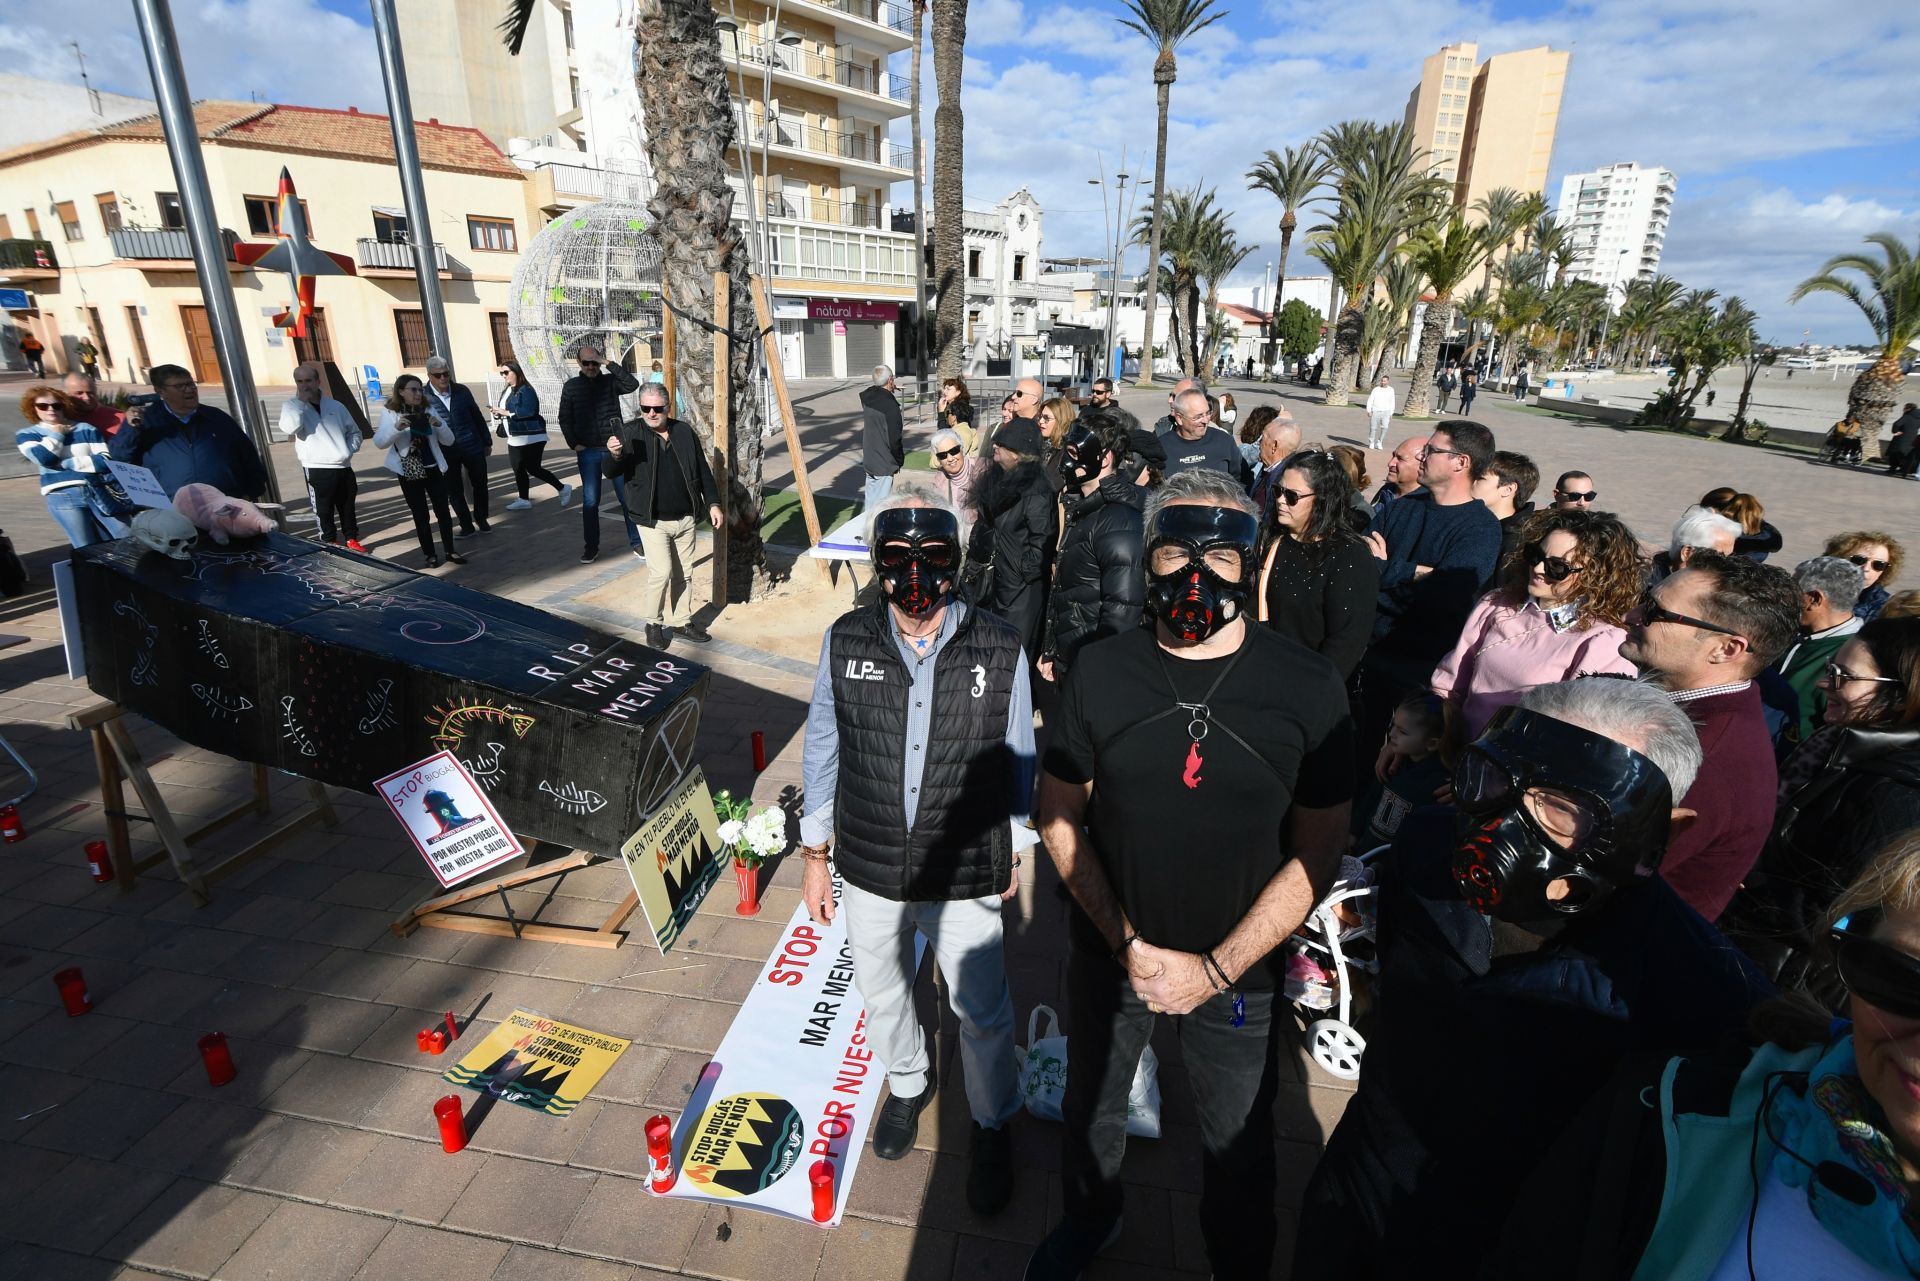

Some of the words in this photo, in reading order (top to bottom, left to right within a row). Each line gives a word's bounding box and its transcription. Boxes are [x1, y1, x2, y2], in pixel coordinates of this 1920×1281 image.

[571, 658, 636, 695] MAR
[845, 660, 874, 679] ILP
[600, 661, 689, 719] MENOR
[392, 771, 423, 807] STOP
[627, 851, 636, 866] NI
[635, 842, 646, 857] EN
[643, 832, 653, 846] TU
[652, 806, 676, 836] PUEBLO
[674, 798, 682, 813] NI
[680, 790, 689, 804] EN
[687, 784, 696, 796] EL
[662, 829, 677, 851] STOP
[666, 841, 682, 865] MAR
[679, 818, 700, 850] MENOR
[439, 862, 455, 875] POR
[454, 848, 485, 868] NUESTRA
[446, 836, 476, 857] NUESTRO
[768, 926, 823, 986] STOP
[509, 1015, 536, 1029] PORQUE
[533, 1020, 554, 1032] NO
[549, 1026, 560, 1036] ES
[559, 1029, 570, 1038] DE
[533, 1036, 555, 1048] STOP
[799, 1002, 842, 1046] MAR
[523, 1044, 546, 1058] MAR
[543, 1050, 581, 1068] MENOR
[706, 1140, 732, 1166] MAR
[720, 1098, 752, 1138] MENOR
[809, 1100, 856, 1158] POR
[690, 1136, 714, 1162] STOP
